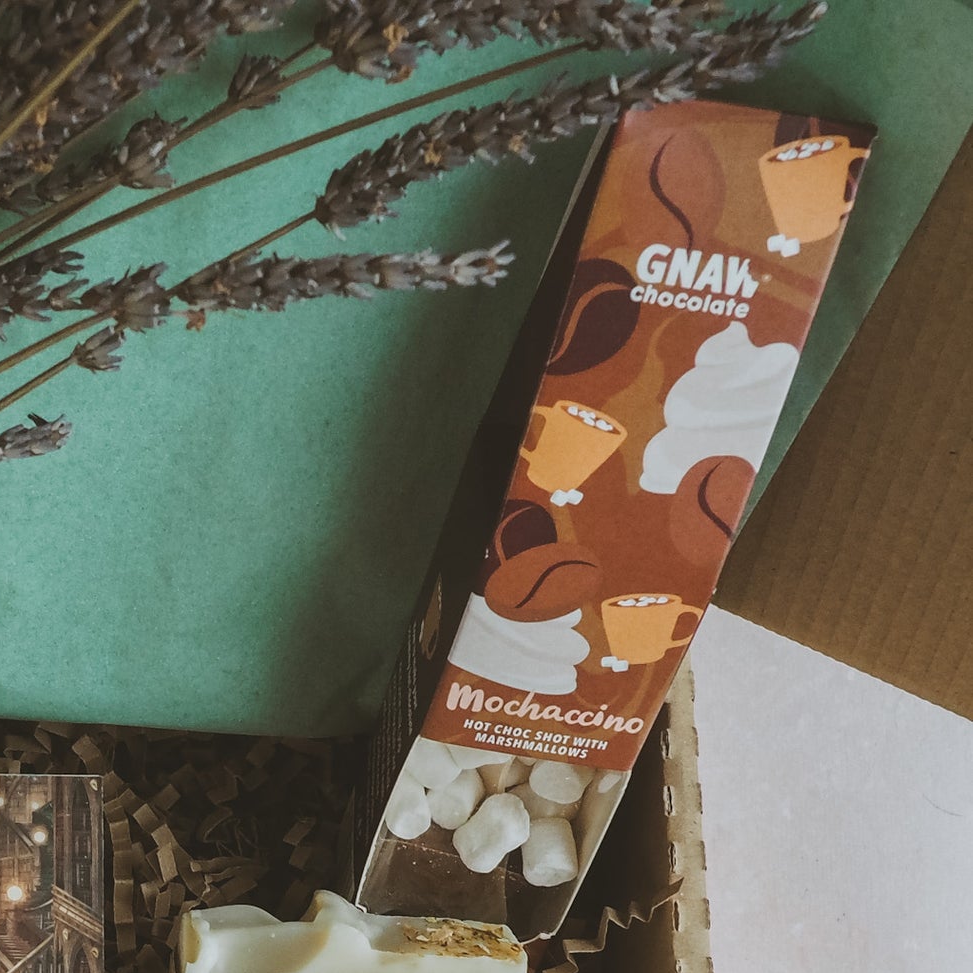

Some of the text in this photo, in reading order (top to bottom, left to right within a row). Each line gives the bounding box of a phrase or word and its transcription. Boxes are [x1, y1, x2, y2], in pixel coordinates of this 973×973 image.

[636, 243, 760, 298] GNAW
[630, 284, 750, 319] chocolate
[445, 682, 645, 735] Mochaccino
[463, 719, 608, 750] HOT CHOC SHOT WITH
[474, 732, 589, 759] MARSHMALLOWS
